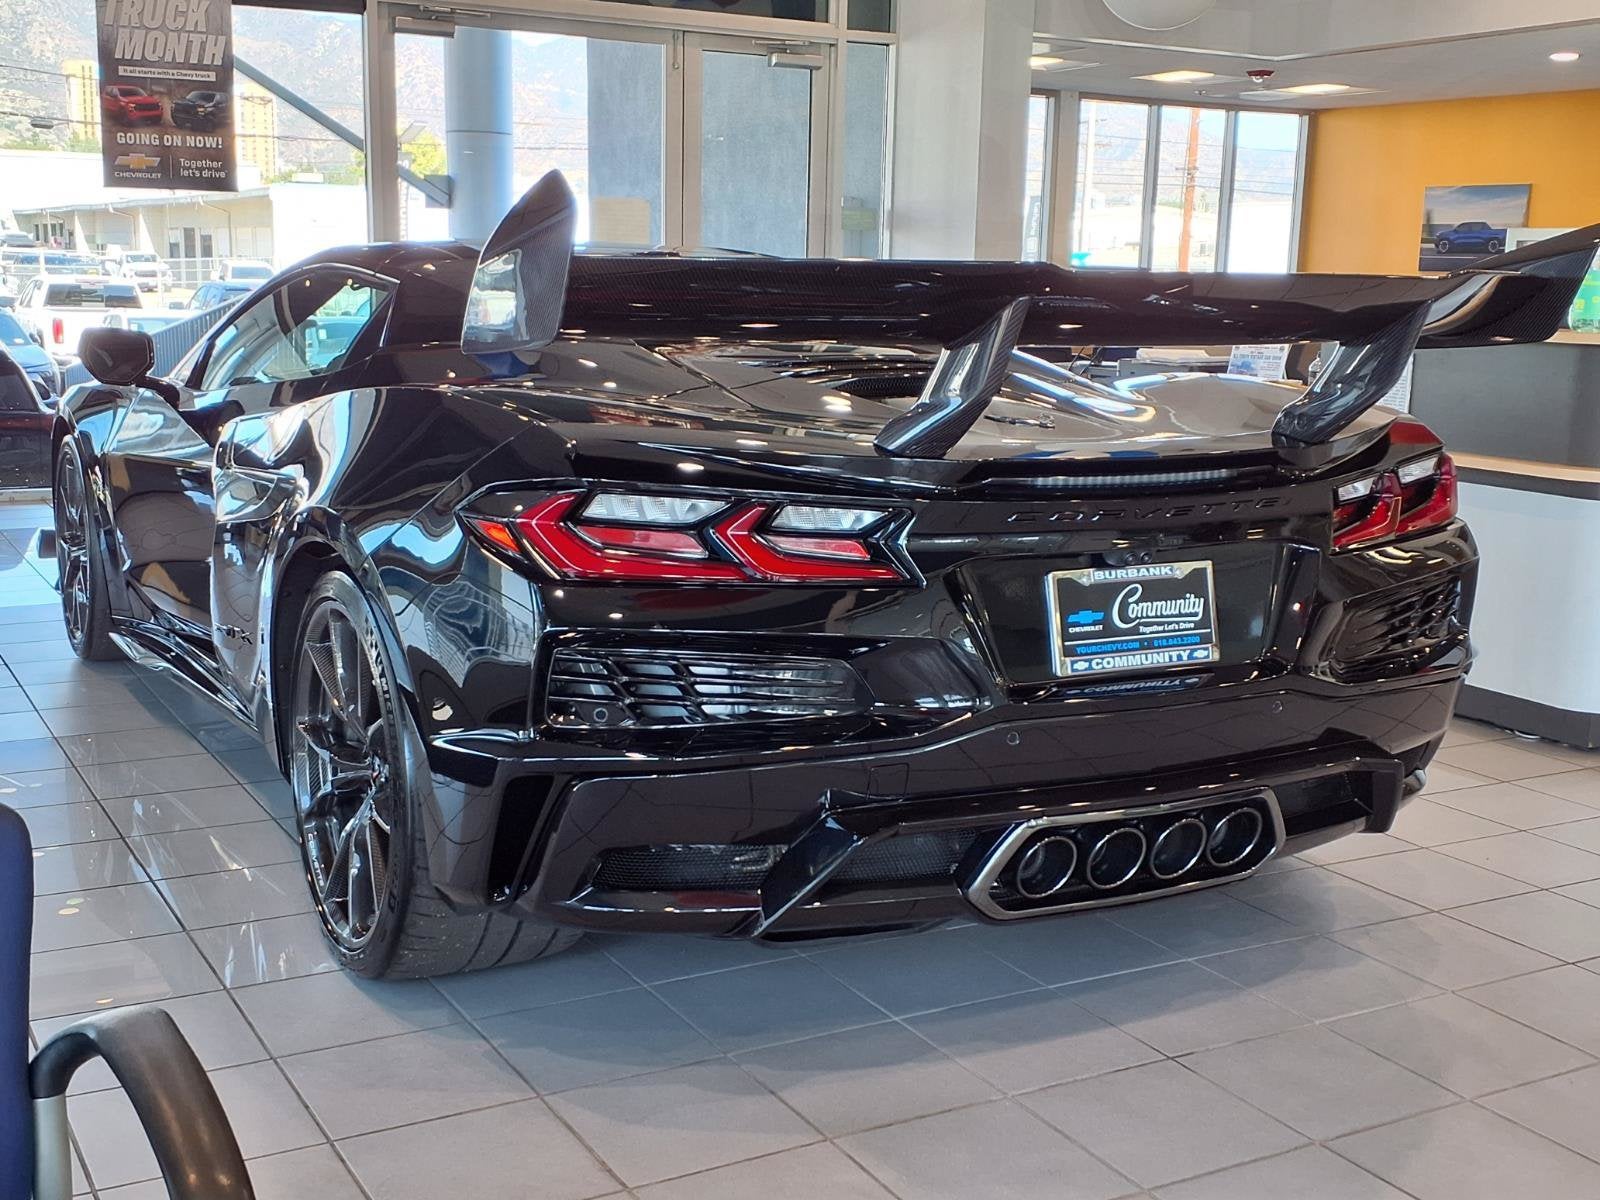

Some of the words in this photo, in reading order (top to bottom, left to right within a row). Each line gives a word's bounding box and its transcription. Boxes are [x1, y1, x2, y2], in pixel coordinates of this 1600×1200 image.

[104, 0, 210, 32] TRUCK
[115, 28, 226, 65] MONTH
[157, 69, 171, 77] with
[176, 71, 194, 79] Chevy
[116, 132, 160, 146] GOING
[164, 134, 182, 147] ON
[186, 135, 223, 149] NOW!
[179, 158, 223, 169] Together
[114, 171, 162, 179] CHEVROLET
[180, 168, 201, 177] let's
[202, 169, 226, 178] drive
[1007, 497, 1280, 522] CORVETTE
[1094, 565, 1174, 580] BURBANK
[1112, 583, 1205, 629] Community
[1139, 625, 1165, 634] Together
[1164, 623, 1179, 631] Let's
[1076, 641, 1140, 654] YOURCHEVY.COM
[1091, 649, 1191, 670] COMMUNITY
[307, 833, 325, 886] CORVETTE
